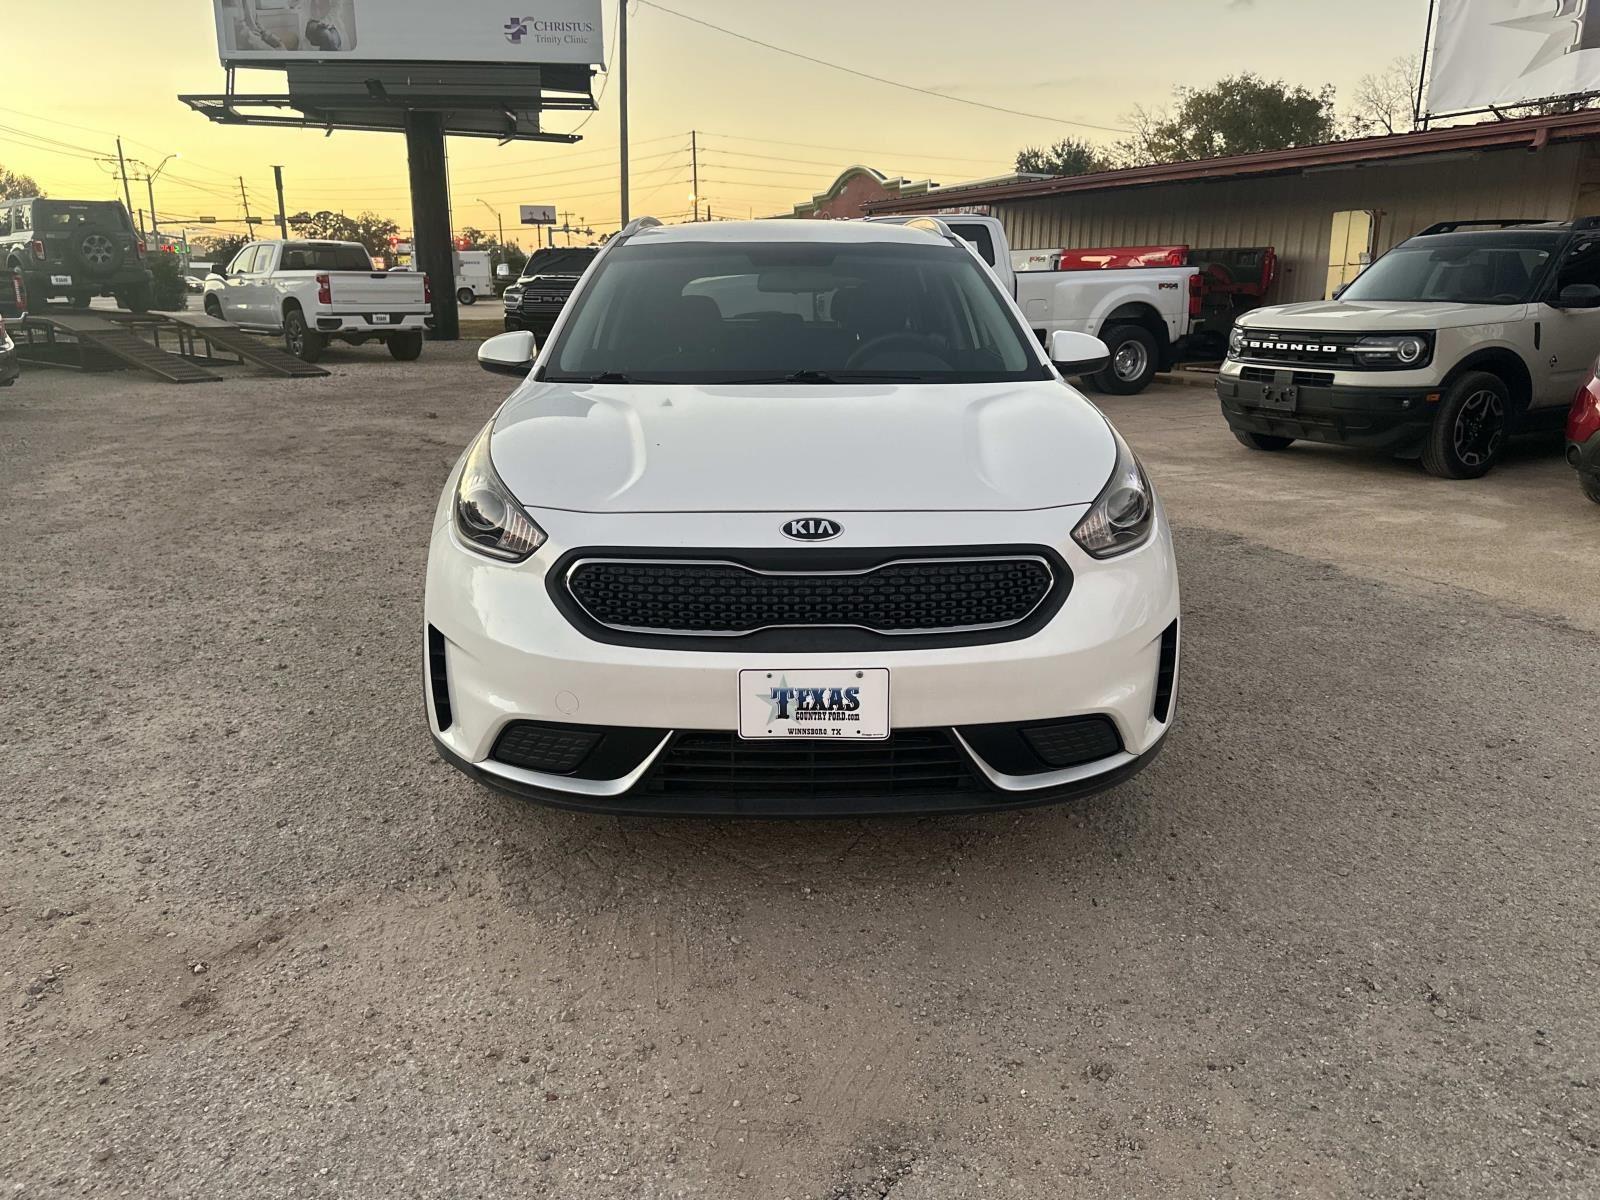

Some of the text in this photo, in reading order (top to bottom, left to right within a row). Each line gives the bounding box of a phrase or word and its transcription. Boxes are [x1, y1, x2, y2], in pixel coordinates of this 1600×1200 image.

[534, 20, 592, 32] CHRISTUS
[535, 34, 588, 45] Trinity Clinic
[1249, 341, 1337, 353] BRONCO
[791, 520, 834, 534] KIA
[770, 687, 860, 719] TEXAS
[795, 711, 860, 721] COUNTRY FORD.com
[787, 728, 842, 736] WINNSBORO TX
